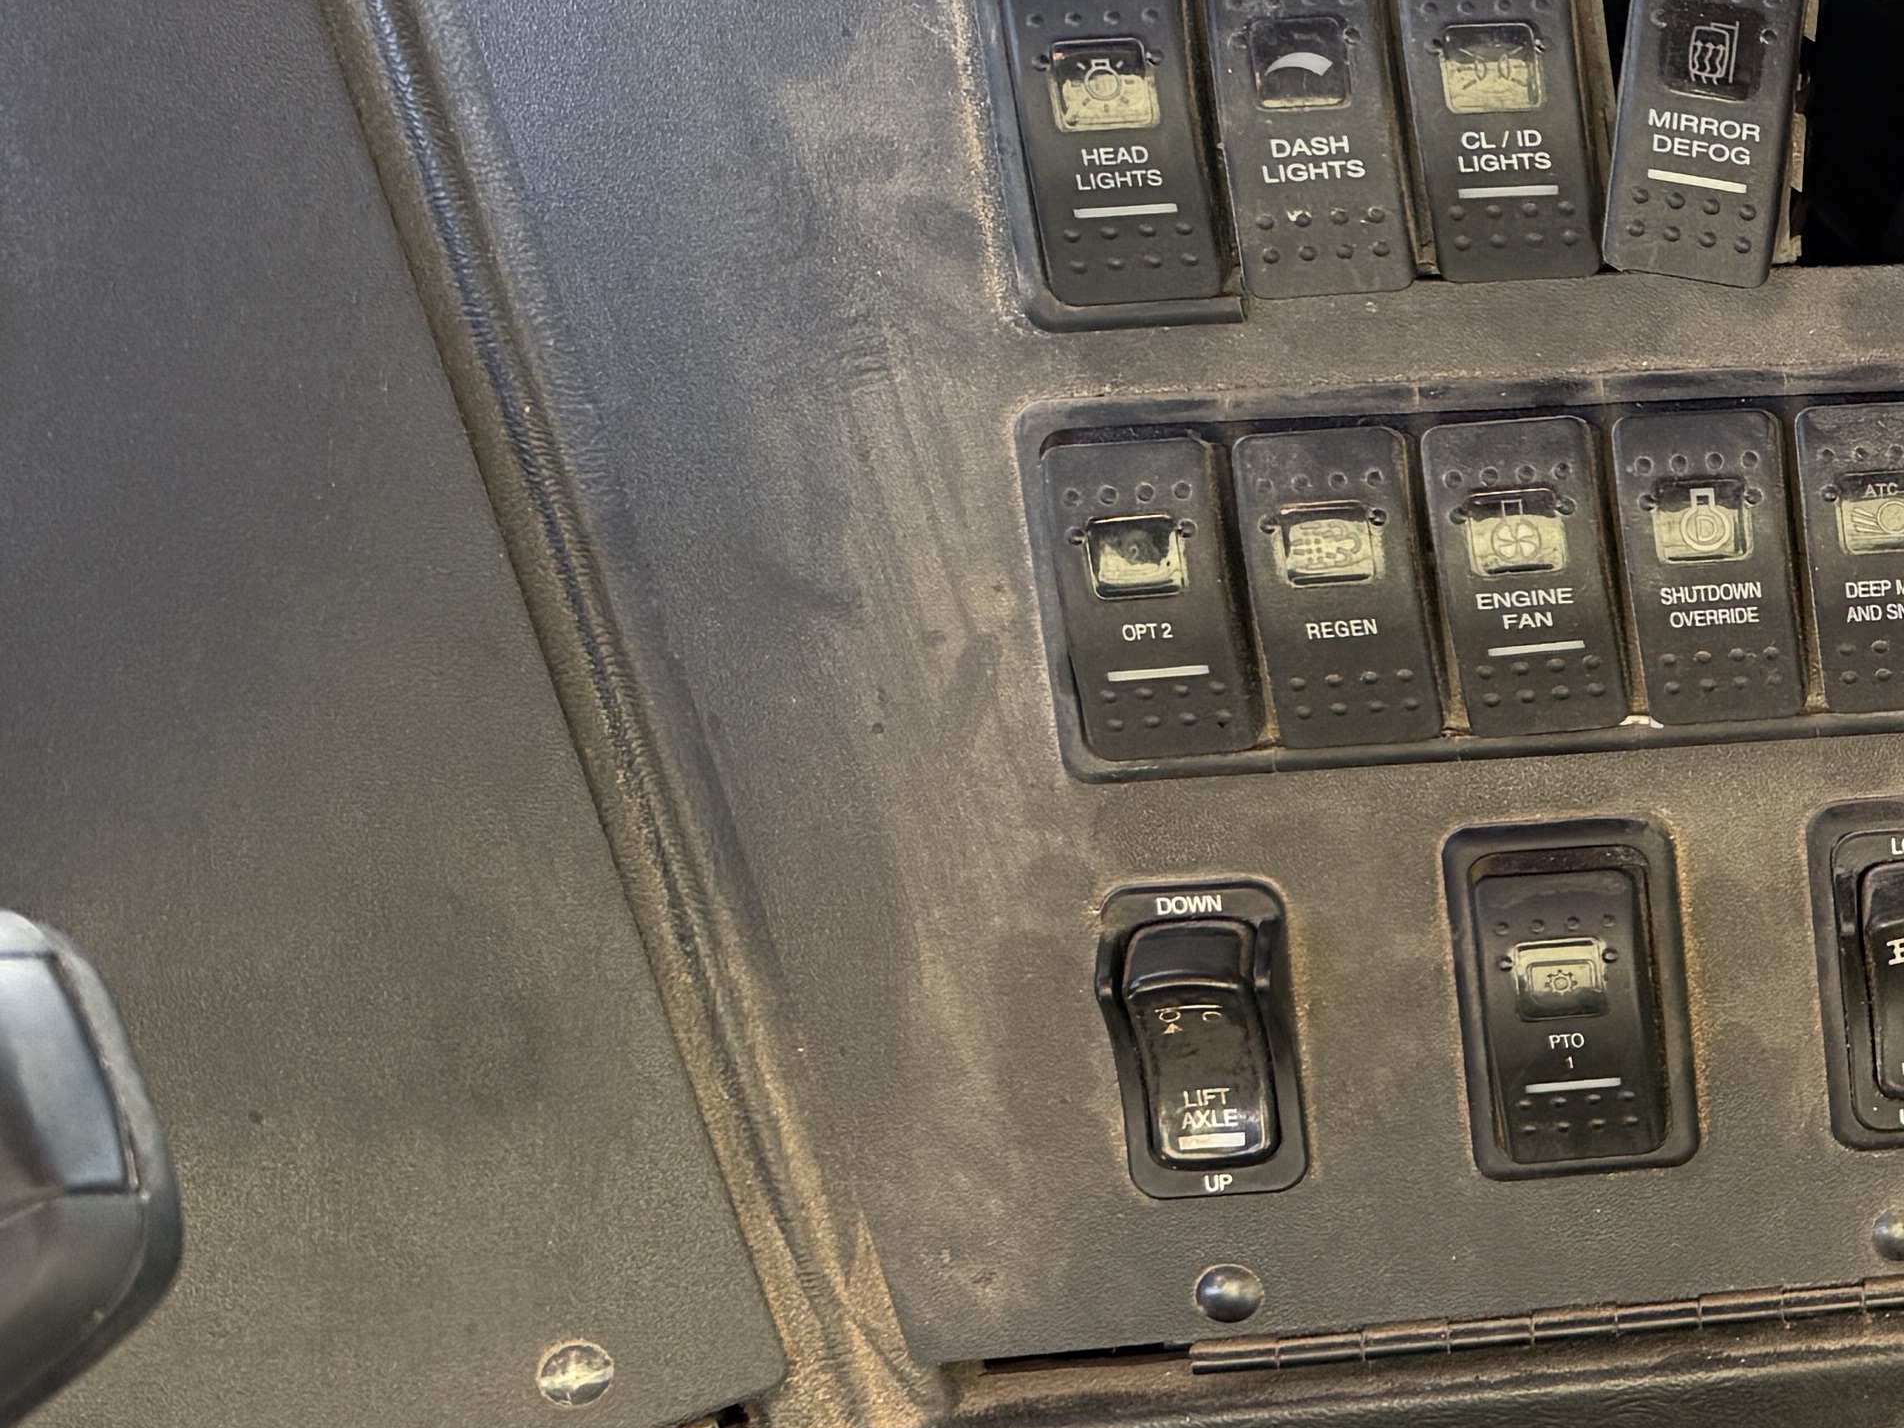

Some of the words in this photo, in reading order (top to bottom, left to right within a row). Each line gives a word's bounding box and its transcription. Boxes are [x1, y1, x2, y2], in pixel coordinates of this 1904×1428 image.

[1647, 107, 1761, 143] MIRROR
[1080, 145, 1149, 167] HEAD
[1269, 135, 1350, 159] DASH
[1651, 133, 1752, 166] DEFOG
[1261, 159, 1367, 185] LIGHTS
[1458, 151, 1552, 174] LIGHTS
[1075, 169, 1163, 192] LIGHTS
[1475, 587, 1574, 612] ENGINE
[1660, 581, 1762, 606] SHUTDOWN
[1845, 579, 1893, 599] DEEP
[1502, 612, 1554, 631] FAN
[1669, 606, 1760, 629] OVERRIDE
[1846, 603, 1883, 623] AND
[1121, 622, 1158, 642] OPT
[1161, 622, 1173, 640] 2
[1305, 618, 1379, 640] REGEN
[1156, 894, 1223, 916] DOWN
[1548, 1032, 1585, 1051] PTO
[1566, 1056, 1575, 1070] 1
[1182, 1087, 1229, 1109] LIFT
[1181, 1107, 1238, 1130] AXLE
[1204, 1173, 1233, 1193] UP
